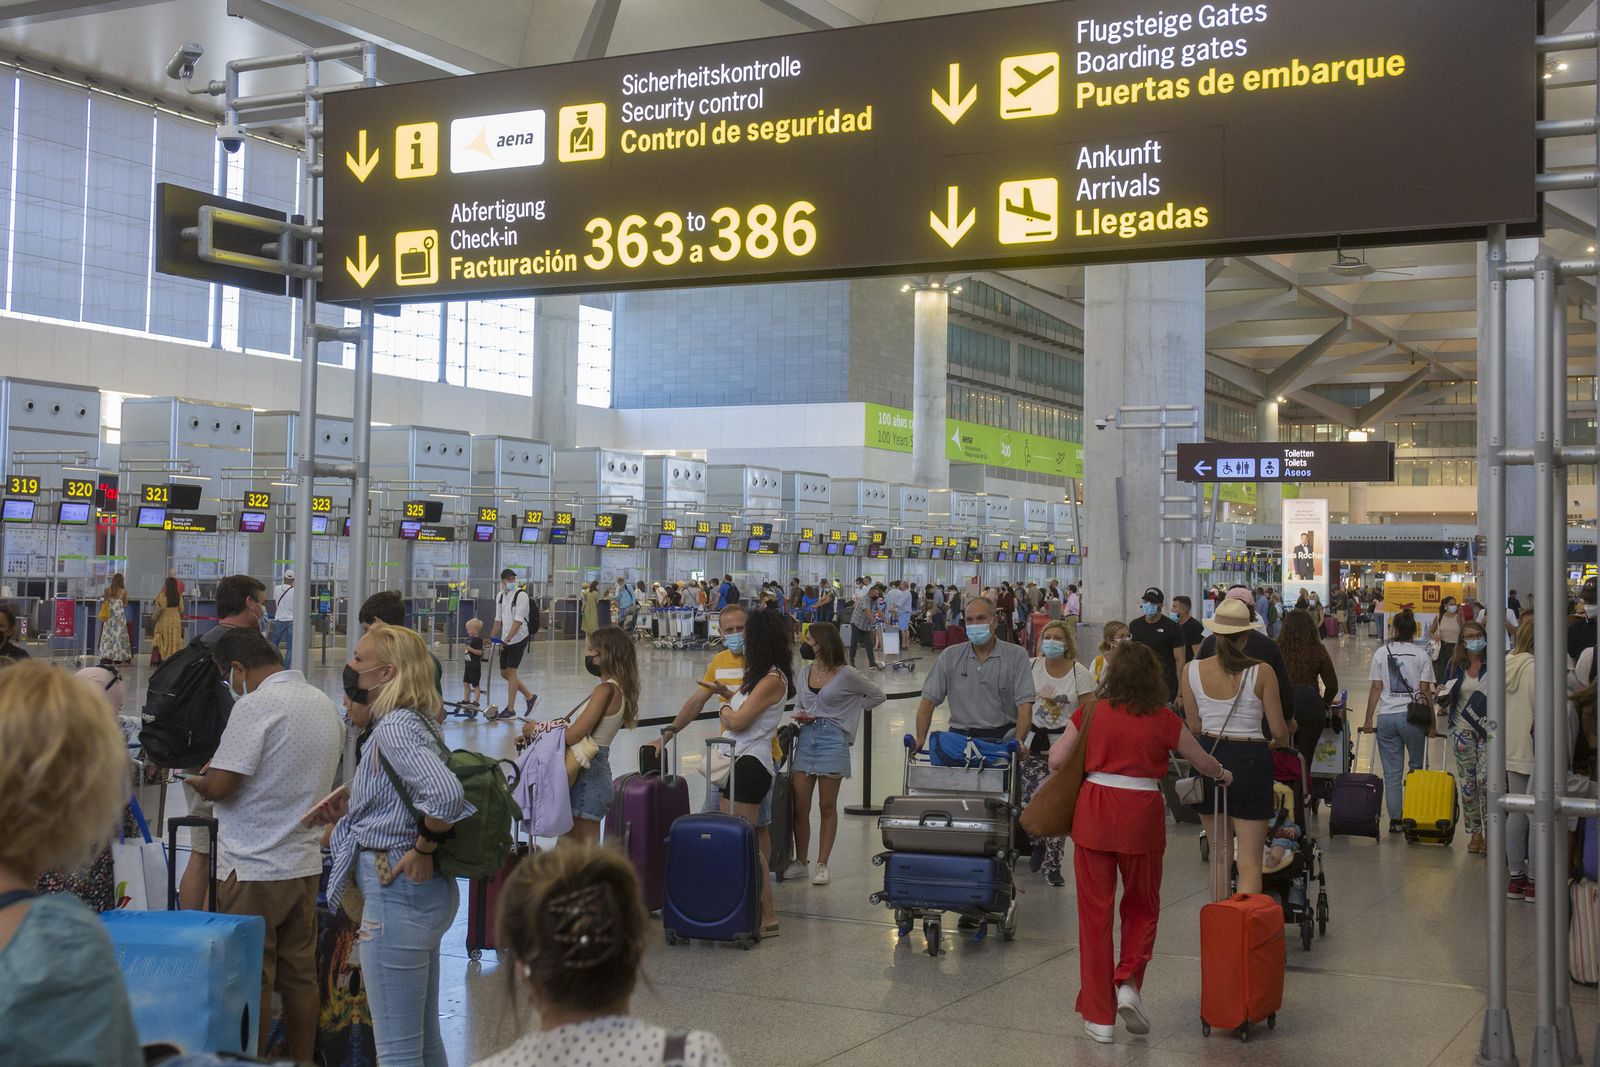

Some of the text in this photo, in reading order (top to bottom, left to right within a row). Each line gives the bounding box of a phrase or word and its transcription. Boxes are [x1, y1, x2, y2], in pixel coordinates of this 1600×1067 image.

[1077, 3, 1268, 44] Flugsteige Gates
[1077, 38, 1248, 75] Boarding gates
[622, 56, 801, 97] Sicherheitskontrolle
[1077, 55, 1405, 109] Puertas de embarque
[622, 88, 763, 124] Security control
[621, 105, 873, 154] Control de seguridad
[496, 131, 534, 149] aena
[1077, 140, 1161, 170] Ankunft
[1077, 173, 1160, 202] Arrivals
[450, 199, 545, 224] Abfertigung
[687, 211, 706, 232] to
[1076, 203, 1209, 239] Llegadas
[450, 227, 517, 250] Check-in
[708, 200, 818, 262] 386
[583, 211, 684, 271] 363
[689, 244, 704, 264] a
[450, 248, 578, 280] Facturación
[878, 411, 892, 426] 100
[878, 430, 891, 444] 100
[892, 432, 908, 447] Years
[1284, 449, 1314, 458] Toiletten
[1284, 458, 1307, 467] Toilets
[1284, 467, 1312, 477] Aseos
[11, 477, 38, 494] 319
[67, 481, 93, 498] 320
[145, 486, 169, 502] 321
[247, 493, 269, 508] 322
[311, 497, 331, 512] 323
[406, 503, 425, 517] 325
[480, 508, 497, 522] 326
[527, 511, 543, 524] 327
[556, 513, 571, 525] 328
[598, 515, 612, 527] 329
[663, 520, 677, 531] 330
[698, 521, 710, 533] 331
[720, 523, 732, 534] 332
[752, 525, 764, 536] 333
[803, 529, 814, 539] 334
